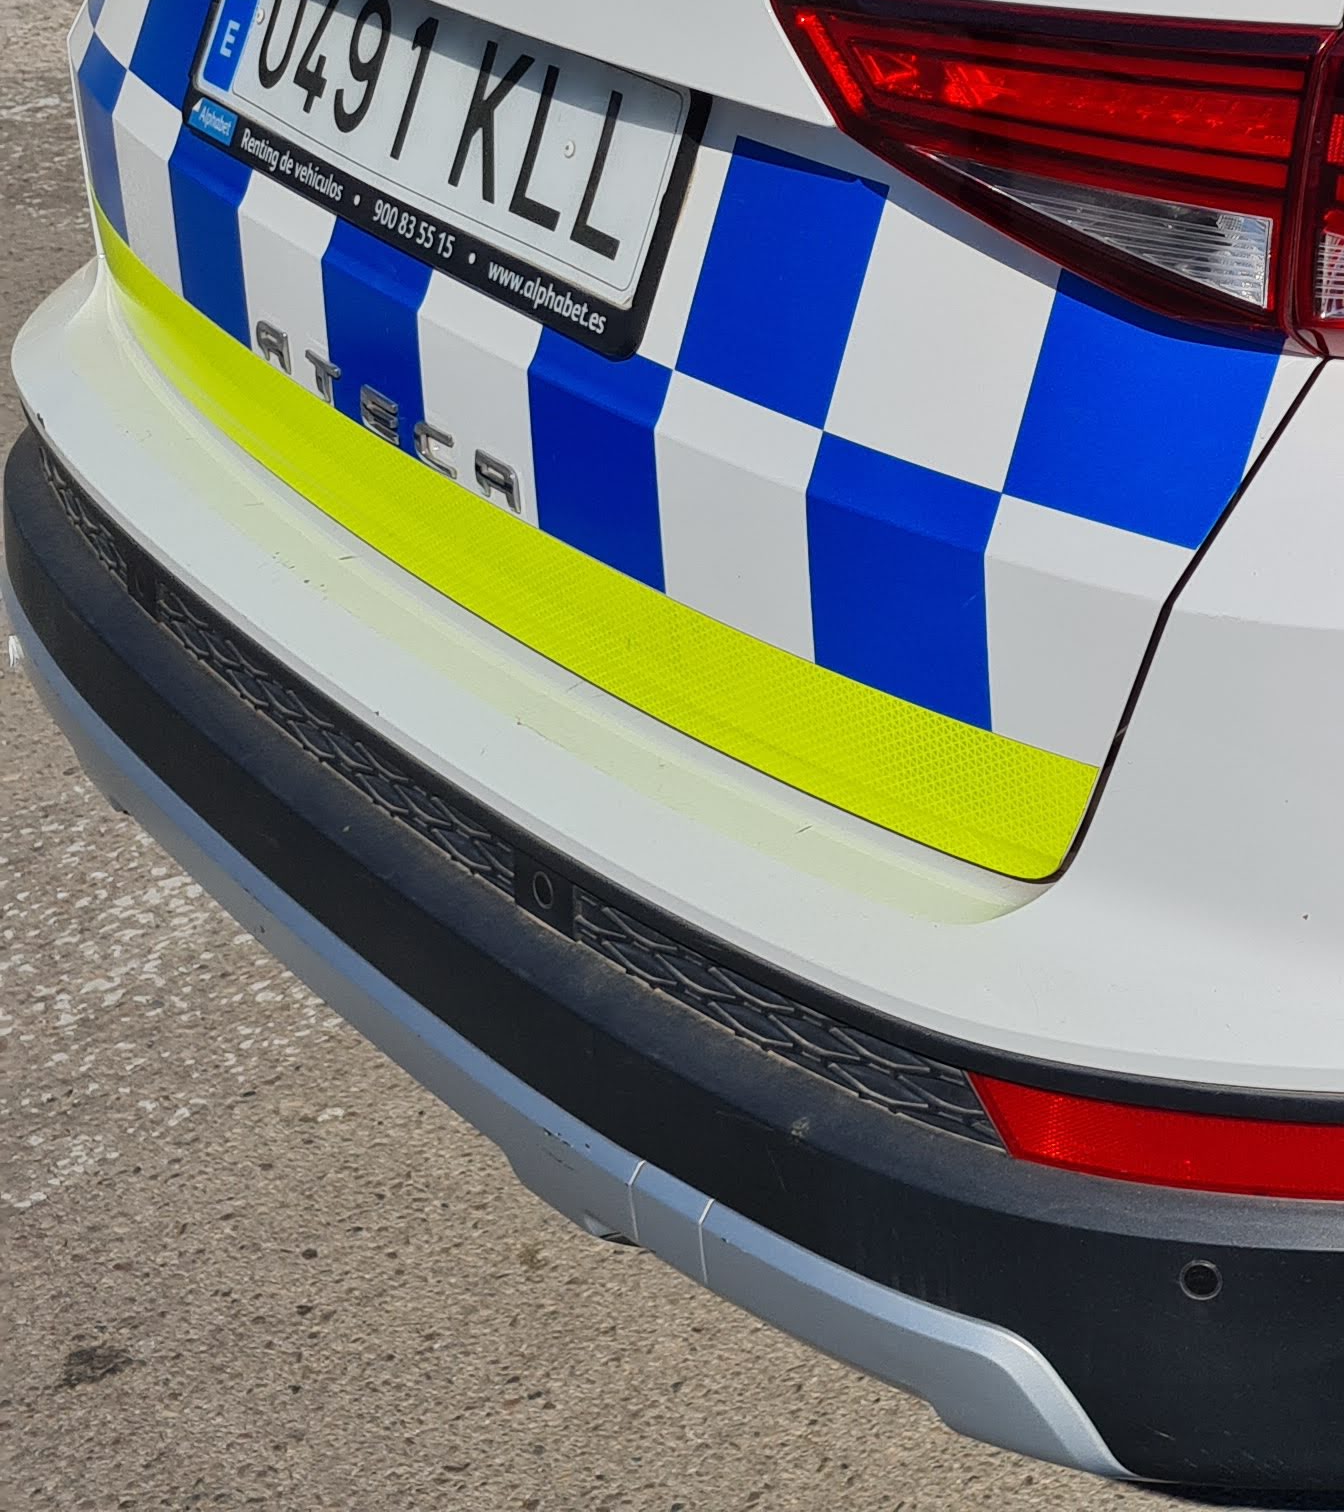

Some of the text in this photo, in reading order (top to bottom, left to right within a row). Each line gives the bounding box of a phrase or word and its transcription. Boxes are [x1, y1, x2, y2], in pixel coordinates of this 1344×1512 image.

[198, 105, 232, 137] Alphabet
[219, 19, 241, 58] E
[241, 127, 280, 172] Renting
[279, 150, 294, 175] de
[372, 199, 399, 230] 900
[398, 212, 416, 239] 83
[416, 219, 437, 249] 55
[437, 232, 456, 259] 15
[487, 261, 608, 335] www.alphabet.es
[447, 40, 623, 262] KLL
[255, 320, 522, 515] ATECA
